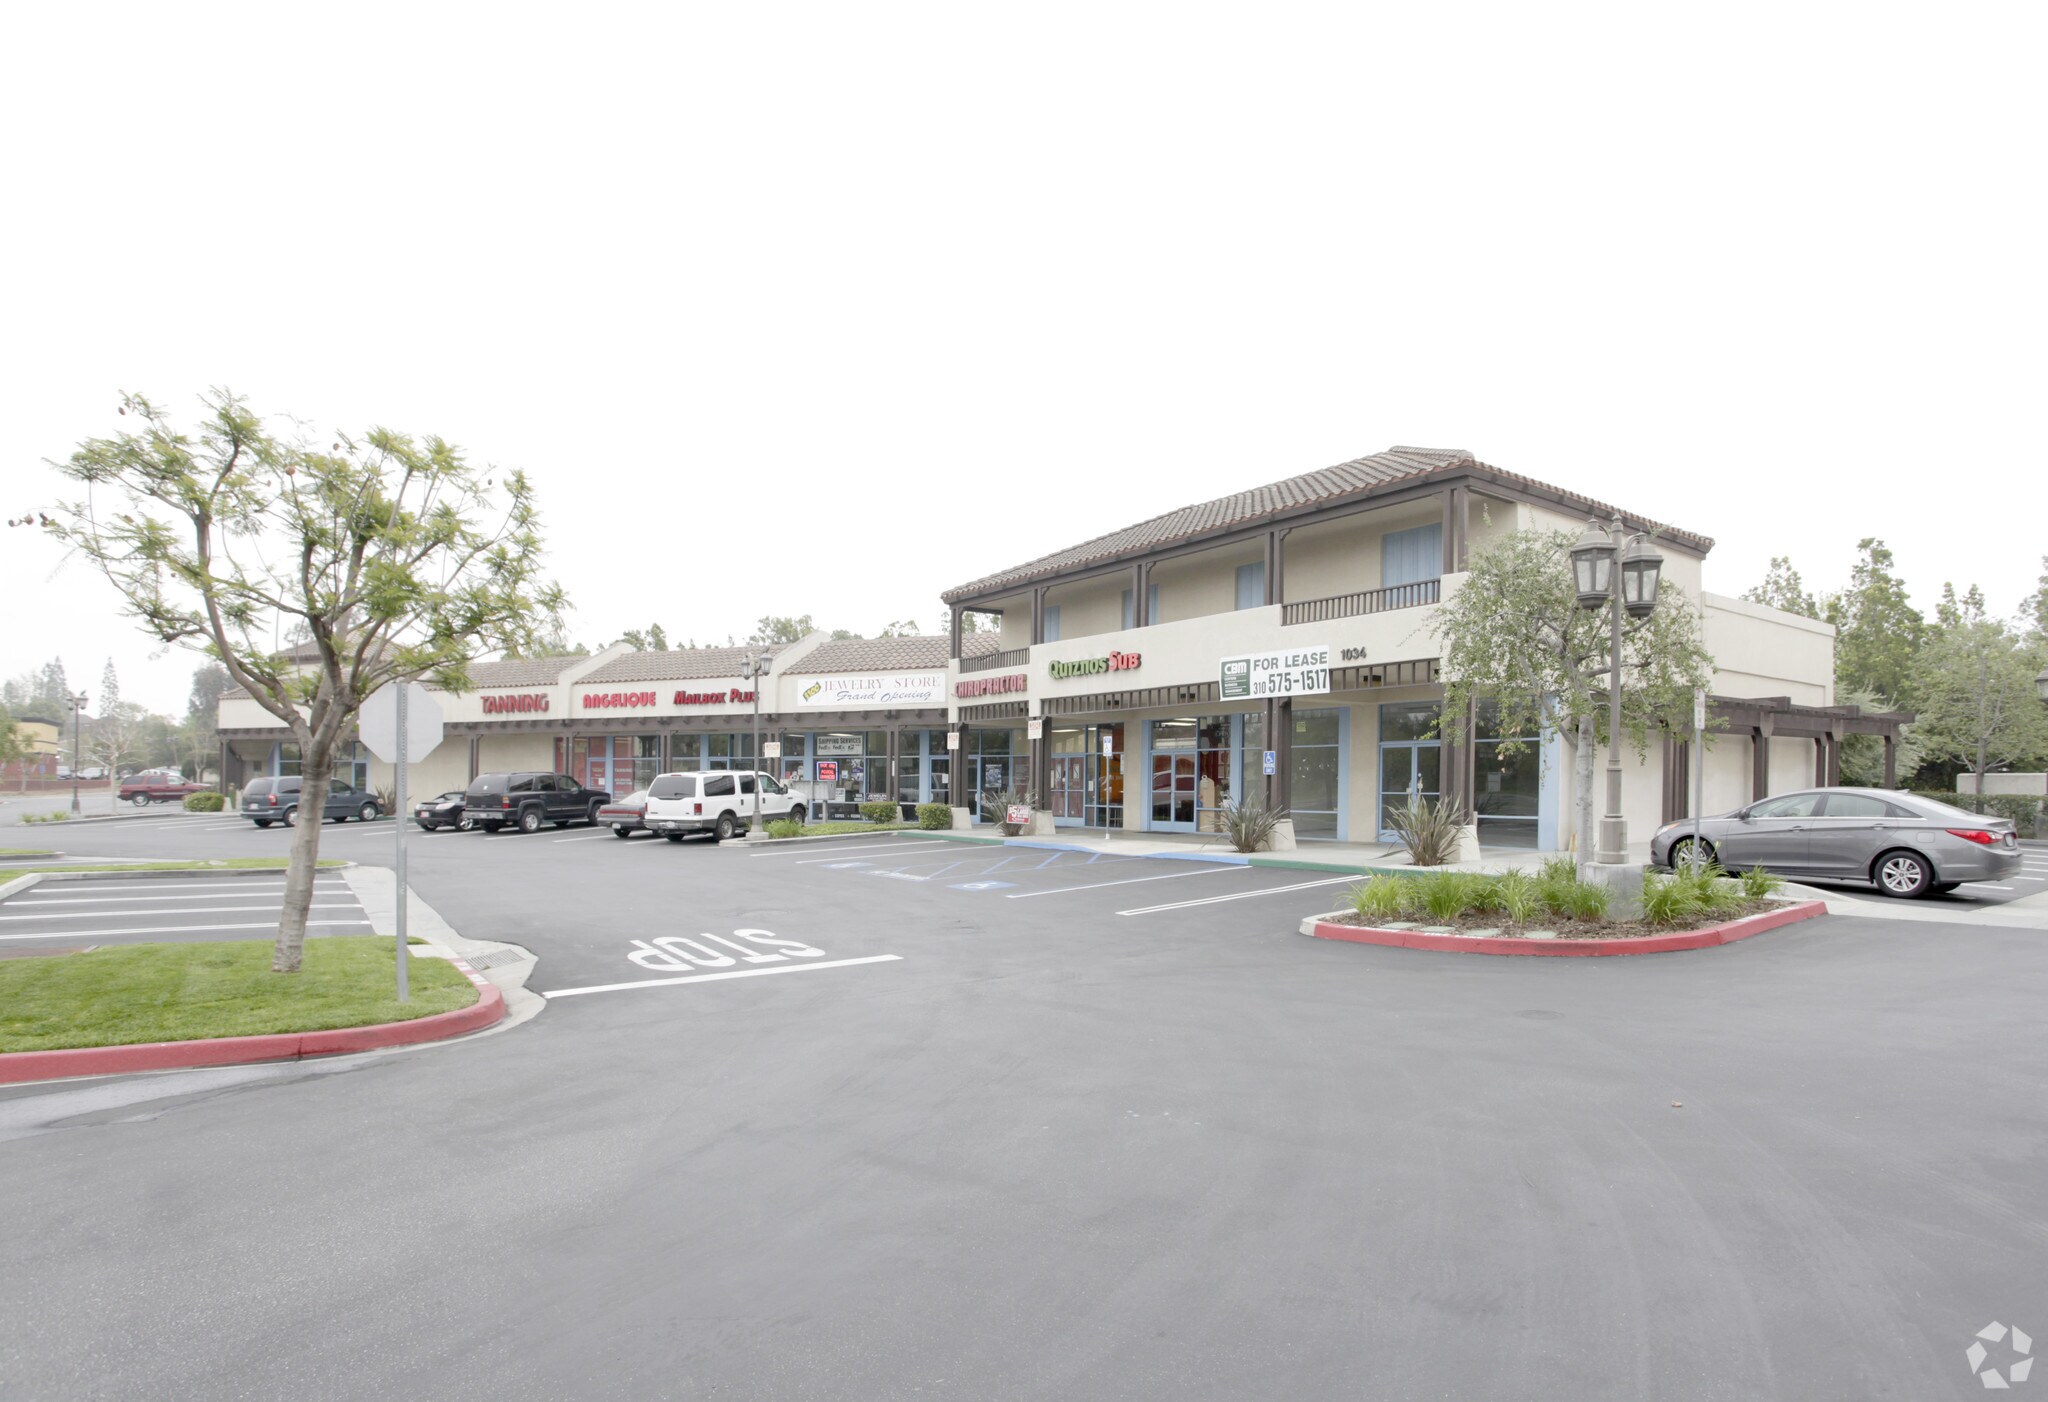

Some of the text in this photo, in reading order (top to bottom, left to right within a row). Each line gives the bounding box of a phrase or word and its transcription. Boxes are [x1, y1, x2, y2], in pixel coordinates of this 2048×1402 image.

[1108, 650, 1142, 672] SUB
[1253, 651, 1328, 671] FOR LEASE
[1340, 647, 1367, 661] 1034
[1224, 661, 1247, 675] CBM
[824, 676, 941, 692] JEWELRY STORE
[954, 673, 1028, 699] CHIROPRACTOR
[1253, 668, 1328, 695] 310 575-1517
[480, 693, 550, 715] TANNING
[582, 691, 656, 709] ANGELIQUE
[673, 690, 726, 706] MAILBOX
[836, 690, 932, 702] Grand Opening
[627, 928, 826, 972] STOP
